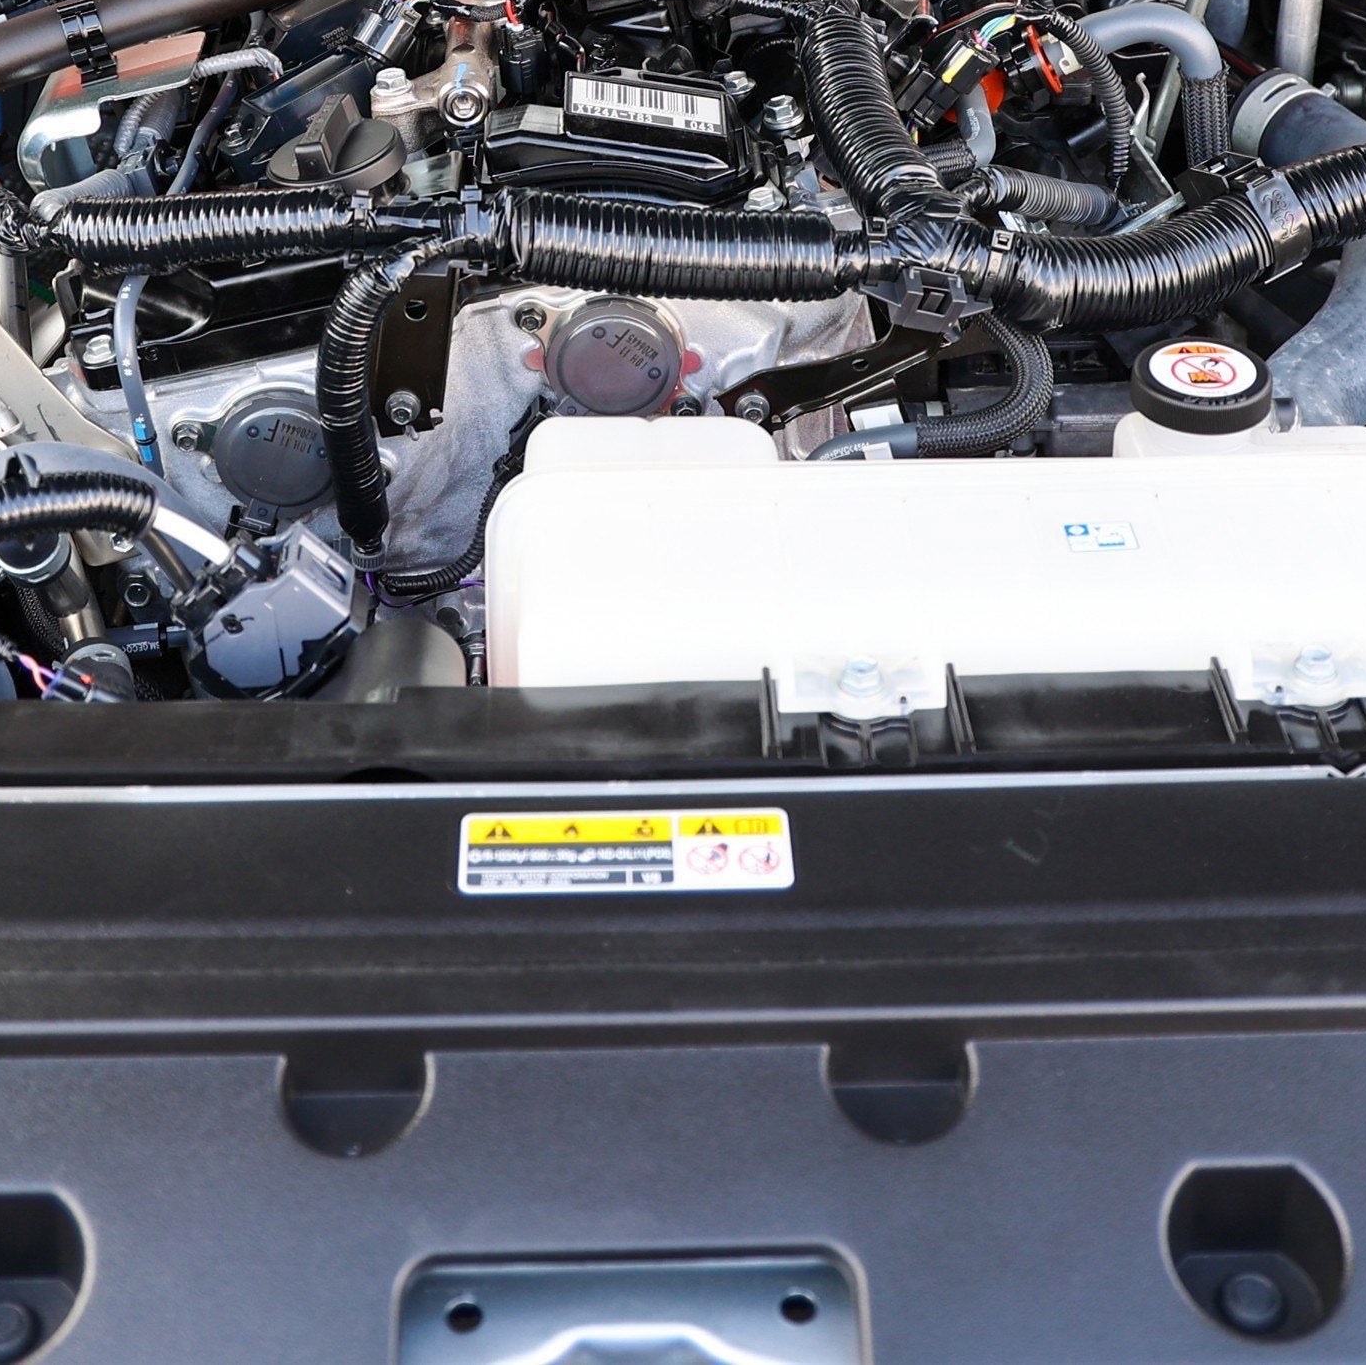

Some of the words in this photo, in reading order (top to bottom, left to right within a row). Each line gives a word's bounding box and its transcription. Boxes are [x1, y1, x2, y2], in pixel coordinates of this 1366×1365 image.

[322, 26, 345, 40] TOYOTA
[690, 122, 715, 133] 043
[1274, 211, 1300, 241] 32
[606, 328, 630, 349] F
[264, 419, 280, 443] F
